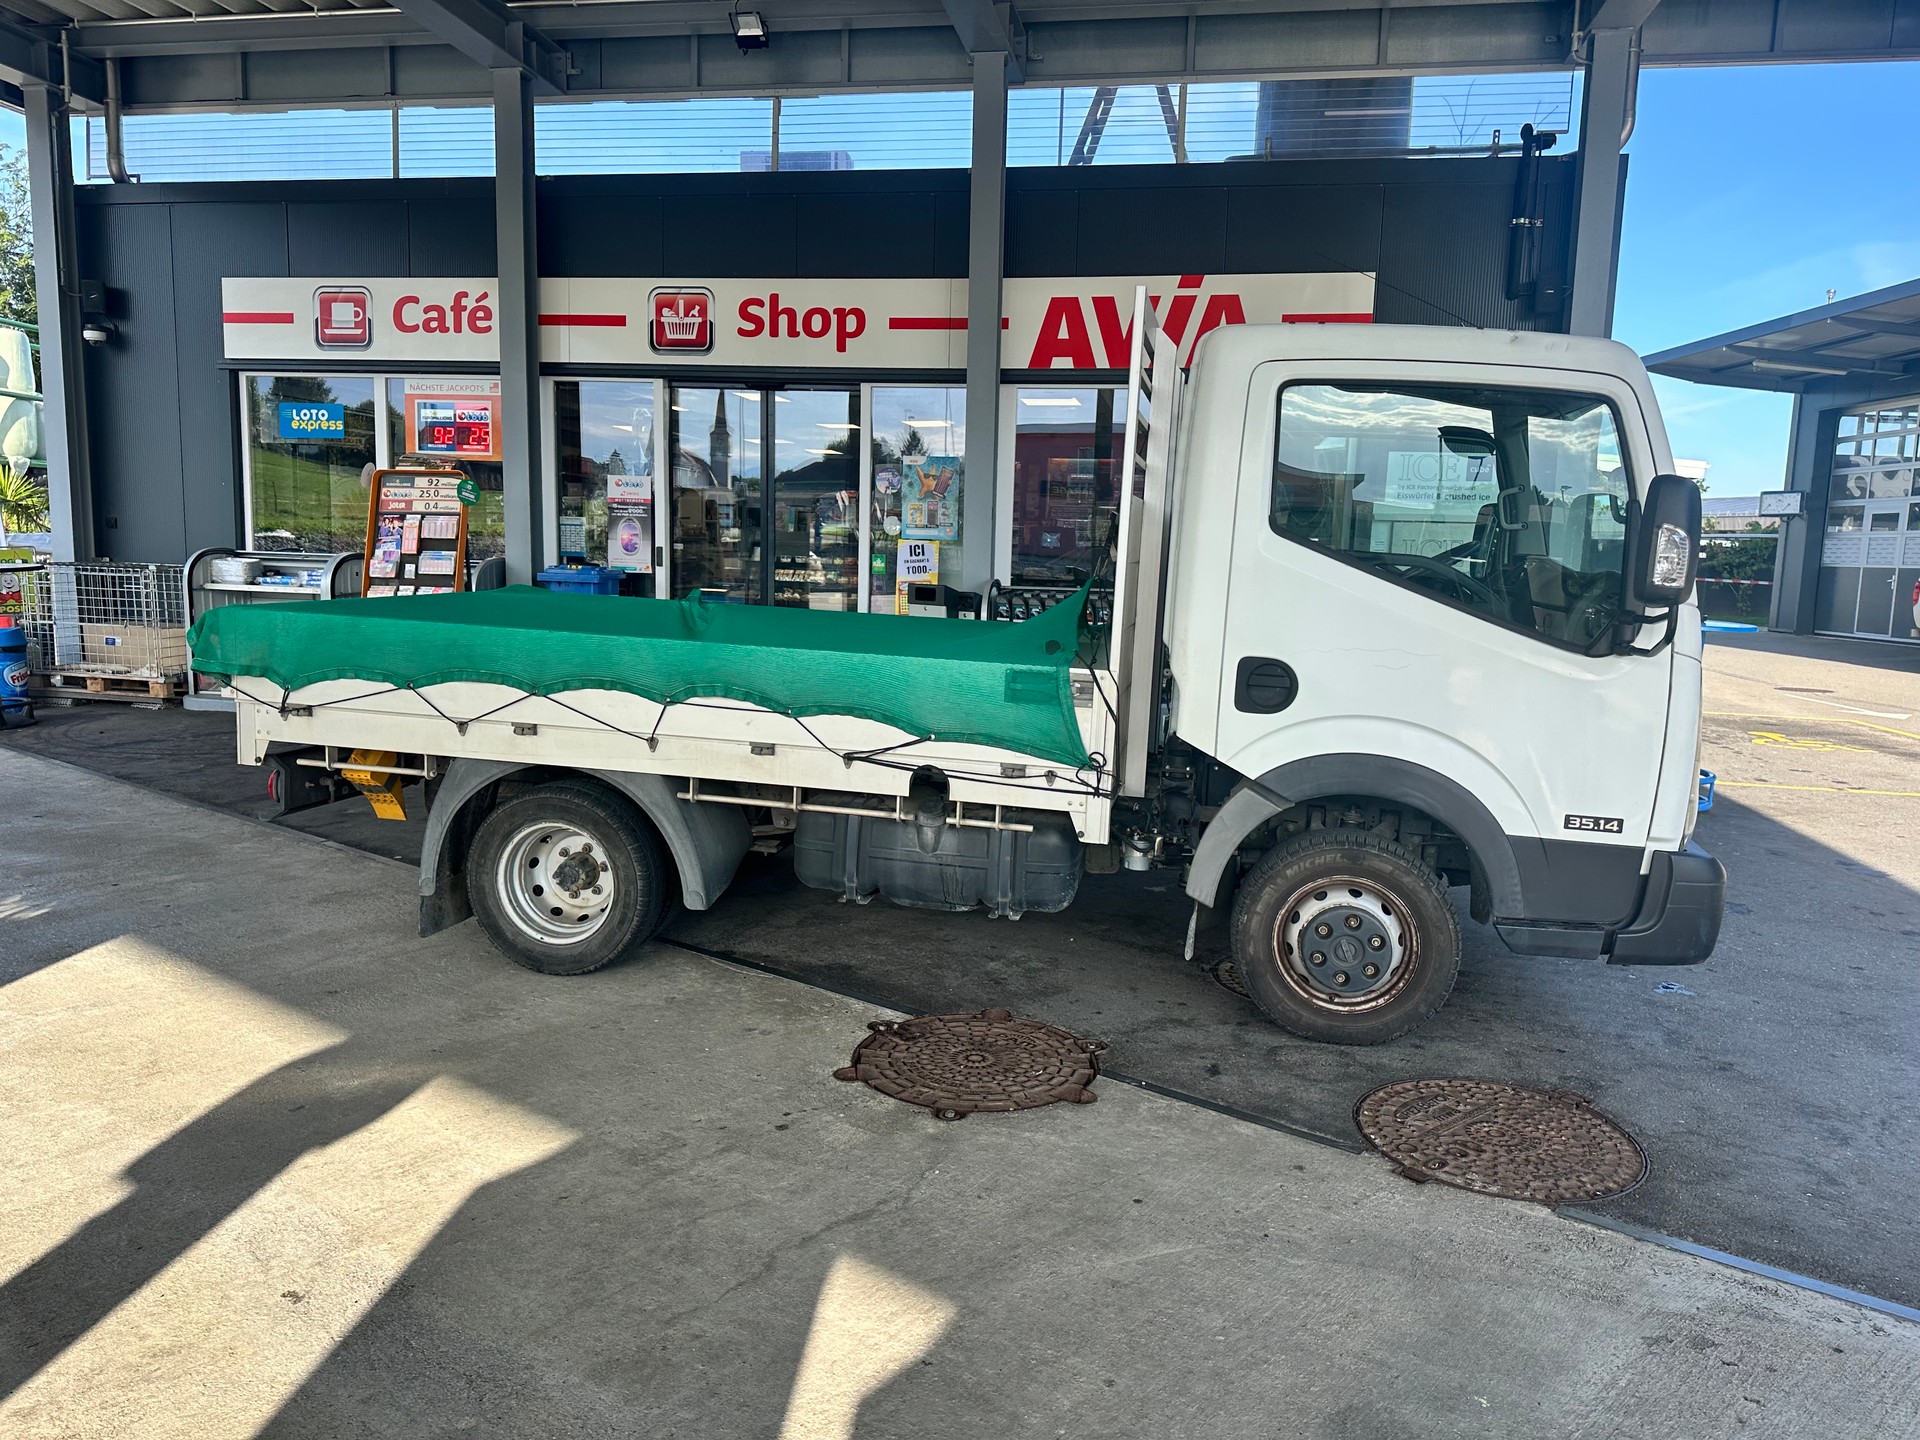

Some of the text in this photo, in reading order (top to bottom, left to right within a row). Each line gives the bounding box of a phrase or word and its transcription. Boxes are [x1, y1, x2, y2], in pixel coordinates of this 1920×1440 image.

[392, 290, 493, 334] Café
[736, 292, 867, 353] Shop
[1028, 275, 1247, 368] AVIA
[409, 382, 485, 393] NÄCHSTE JACKPOTS
[292, 408, 328, 421] LOTO
[291, 419, 344, 432] express
[433, 426, 455, 445] 92
[469, 427, 490, 445] 25
[1398, 453, 1461, 482] ICE
[427, 477, 441, 487] 92
[1397, 491, 1435, 500] Eiswürfel
[1444, 493, 1477, 501] crushed
[387, 501, 406, 510] JOKER
[909, 543, 925, 557] ICI
[1568, 816, 1621, 833] 35.14
